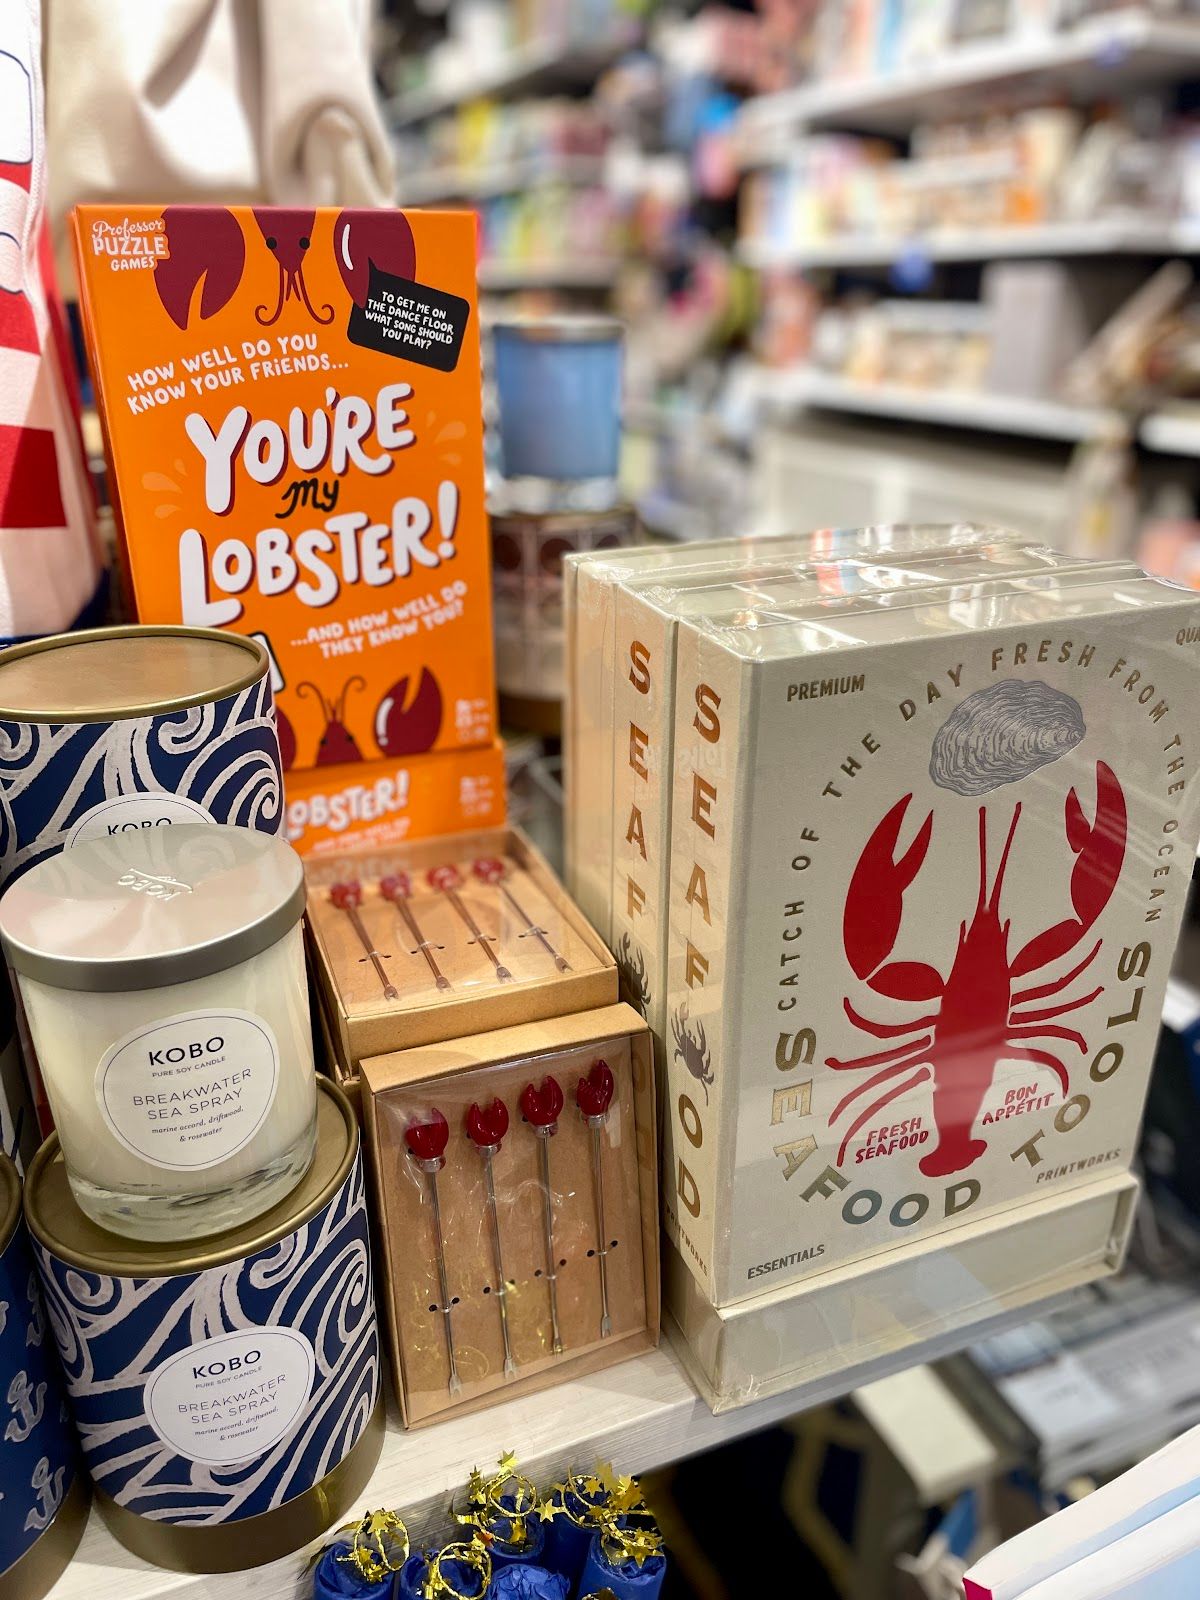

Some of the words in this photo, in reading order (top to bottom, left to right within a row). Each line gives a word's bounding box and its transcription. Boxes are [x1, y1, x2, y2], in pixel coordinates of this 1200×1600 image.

[91, 218, 162, 239] Professor
[92, 236, 166, 256] PUZZLE
[110, 256, 155, 271] GAMES
[367, 298, 386, 312] THE
[388, 305, 421, 323] DANCE
[422, 316, 454, 335] FLOOR,
[382, 291, 395, 303] TO
[396, 296, 416, 310] GET
[416, 302, 430, 315] ME
[432, 308, 447, 320] ON
[365, 310, 392, 326] WHAT
[393, 320, 417, 334] SONG
[417, 326, 453, 345] SHOULD
[382, 327, 402, 341] YOU
[403, 333, 432, 350] PLAY?
[127, 361, 175, 392] HOW
[181, 346, 238, 374] WELL
[241, 339, 271, 359] DO
[276, 333, 317, 354] YOU
[126, 381, 186, 415] KNOW
[190, 366, 245, 395] YOUR
[184, 382, 415, 515] YOU'RE
[178, 480, 458, 628] LOBSTER!
[290, 621, 344, 647] ...AND
[347, 610, 389, 634] HOW
[392, 594, 440, 621] WELL
[440, 580, 468, 602] DO
[319, 635, 365, 660] THEY
[368, 620, 419, 647] KNOW
[422, 598, 465, 630] YOU?
[991, 638, 1097, 671] FRESH
[786, 673, 866, 703] PREMIUM
[898, 663, 964, 722] DAY
[1108, 657, 1169, 725] FROM
[822, 733, 881, 801] THE
[1162, 733, 1186, 796] THE
[285, 768, 410, 841] OBSTER!
[791, 826, 820, 872] OF
[1144, 818, 1179, 924] OCEAN
[777, 899, 805, 1012] CATCH
[148, 1036, 225, 1066] KOBO
[152, 1069, 174, 1078] PURE
[176, 1066, 192, 1075] SOY
[194, 1056, 226, 1071] CANDLE
[133, 1068, 252, 1106] BREAKWATER
[769, 1026, 982, 1228] SEAFOOD
[1009, 940, 1153, 1169] TOOLS
[1004, 1082, 1039, 1106] BON
[147, 1107, 183, 1120] SEA
[189, 1087, 243, 1115] SPRAY
[151, 1125, 178, 1134] marine
[179, 1119, 207, 1131] accord,
[208, 1105, 244, 1124] driftwood,
[981, 1092, 1055, 1126] APPÉTIT
[179, 1135, 187, 1143] &
[188, 1126, 223, 1141] rosewater
[855, 1130, 929, 1164] SEAFOOD
[866, 1116, 922, 1147] FRESH
[1035, 1148, 1122, 1184] PRINTWORKS
[746, 1243, 826, 1280] ESSENTIALS
[192, 1350, 261, 1379] KOBO
[195, 1381, 215, 1389] PURE
[216, 1377, 232, 1385] SOY
[233, 1365, 263, 1380] CANDLE
[178, 1374, 287, 1413] BREAKWATER
[191, 1412, 223, 1424] SEA
[228, 1390, 278, 1417] SPRAY
[194, 1427, 218, 1436] marine
[219, 1420, 244, 1432] accord,
[227, 1425, 259, 1439] rosewater
